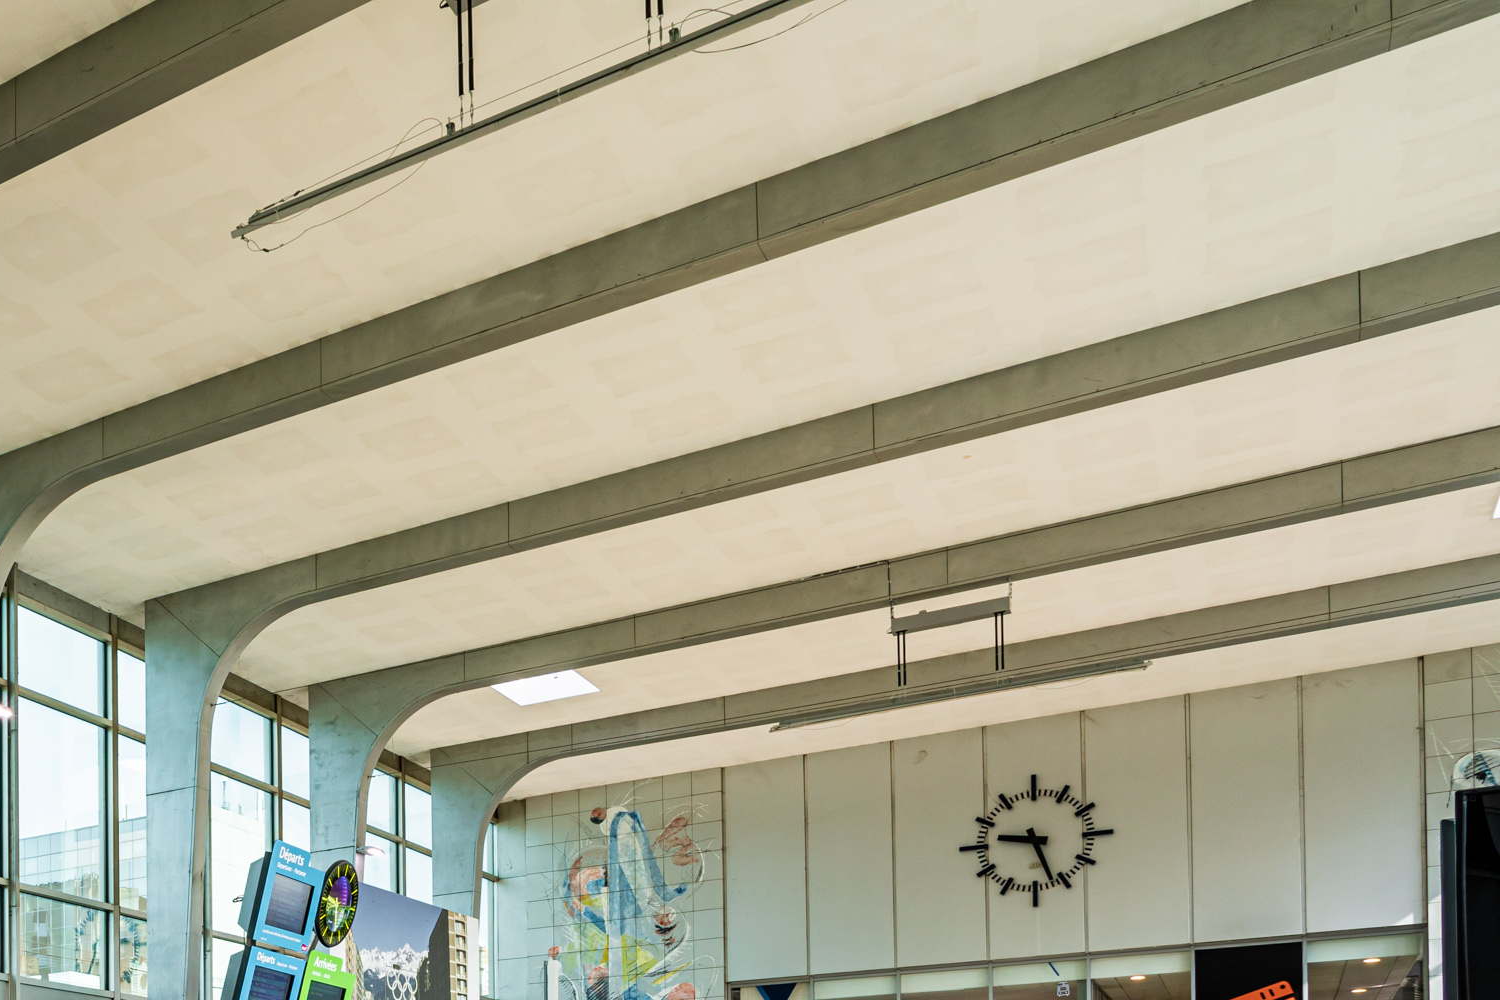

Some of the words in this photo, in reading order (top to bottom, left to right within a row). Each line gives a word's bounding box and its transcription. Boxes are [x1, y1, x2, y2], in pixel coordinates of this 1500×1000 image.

[279, 846, 304, 866] Départs
[256, 952, 276, 964] Départs
[314, 956, 338, 972] Arrivées
